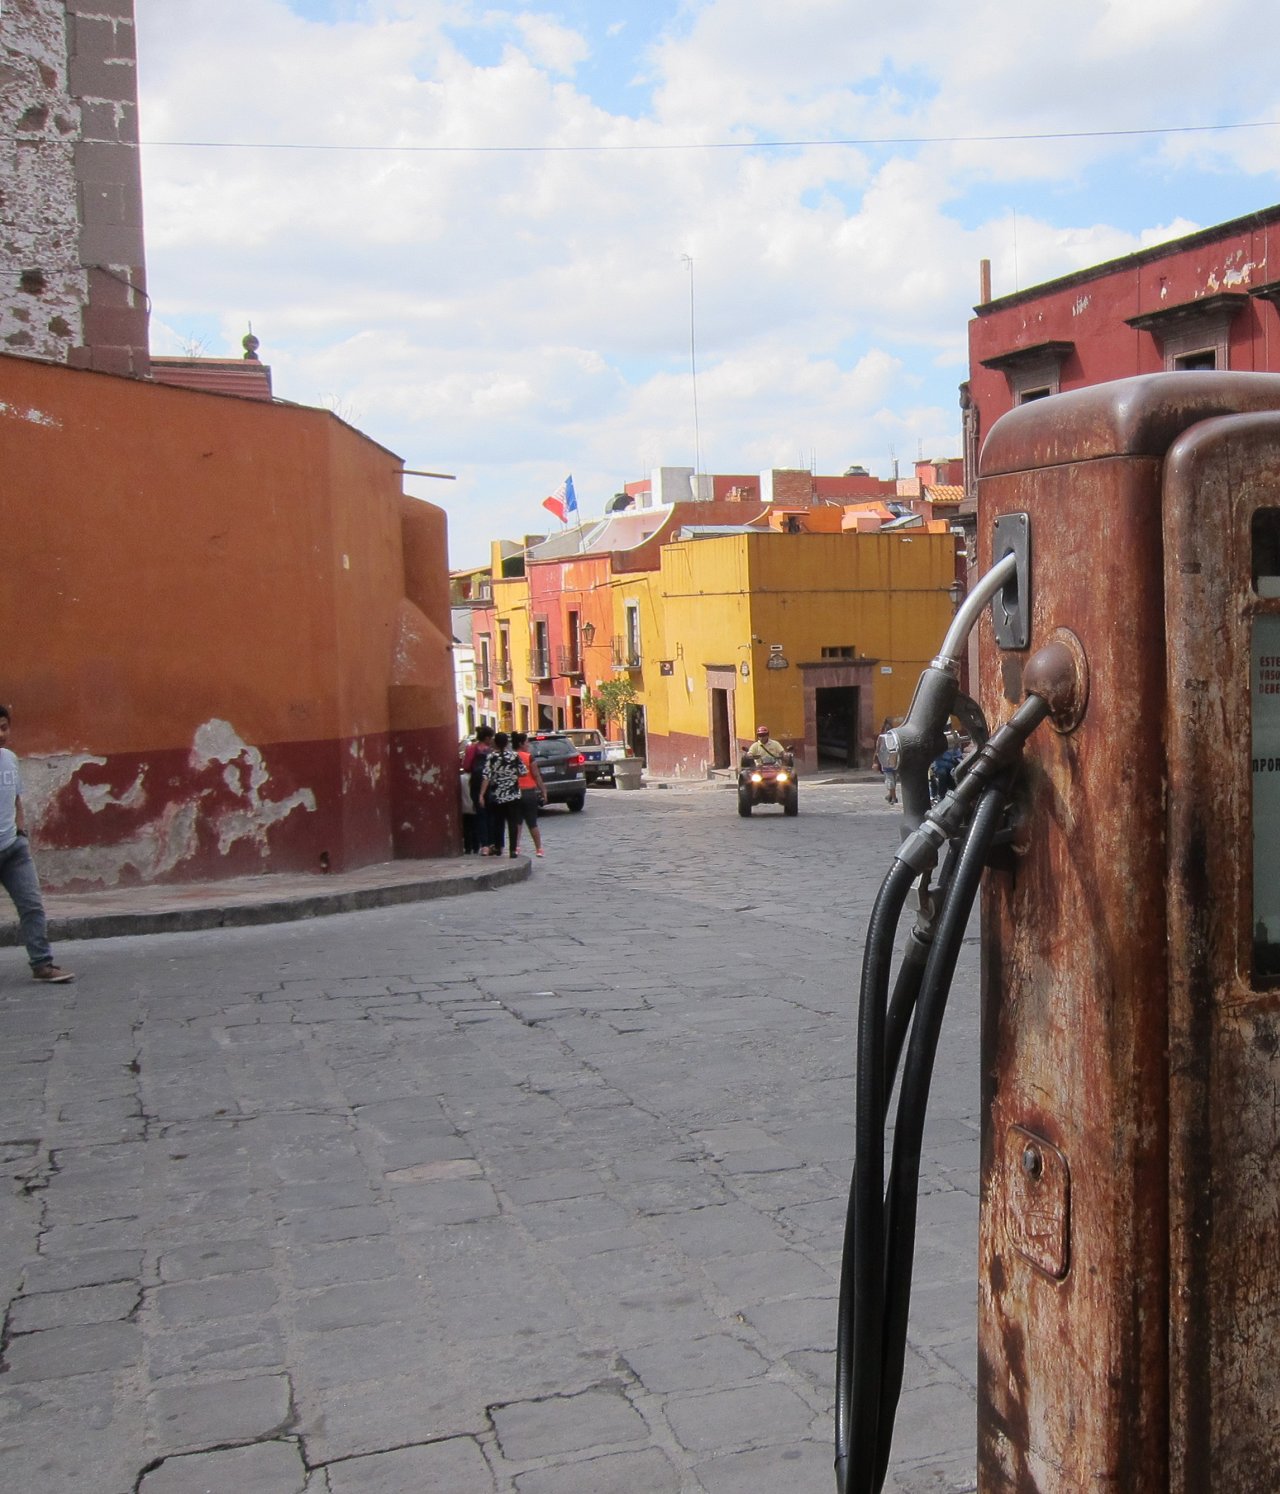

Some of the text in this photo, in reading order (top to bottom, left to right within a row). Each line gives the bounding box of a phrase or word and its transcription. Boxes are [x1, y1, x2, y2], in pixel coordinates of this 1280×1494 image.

[1260, 656, 1280, 667] ESTE
[1260, 670, 1280, 681] VASO
[1259, 683, 1280, 694] DEBE
